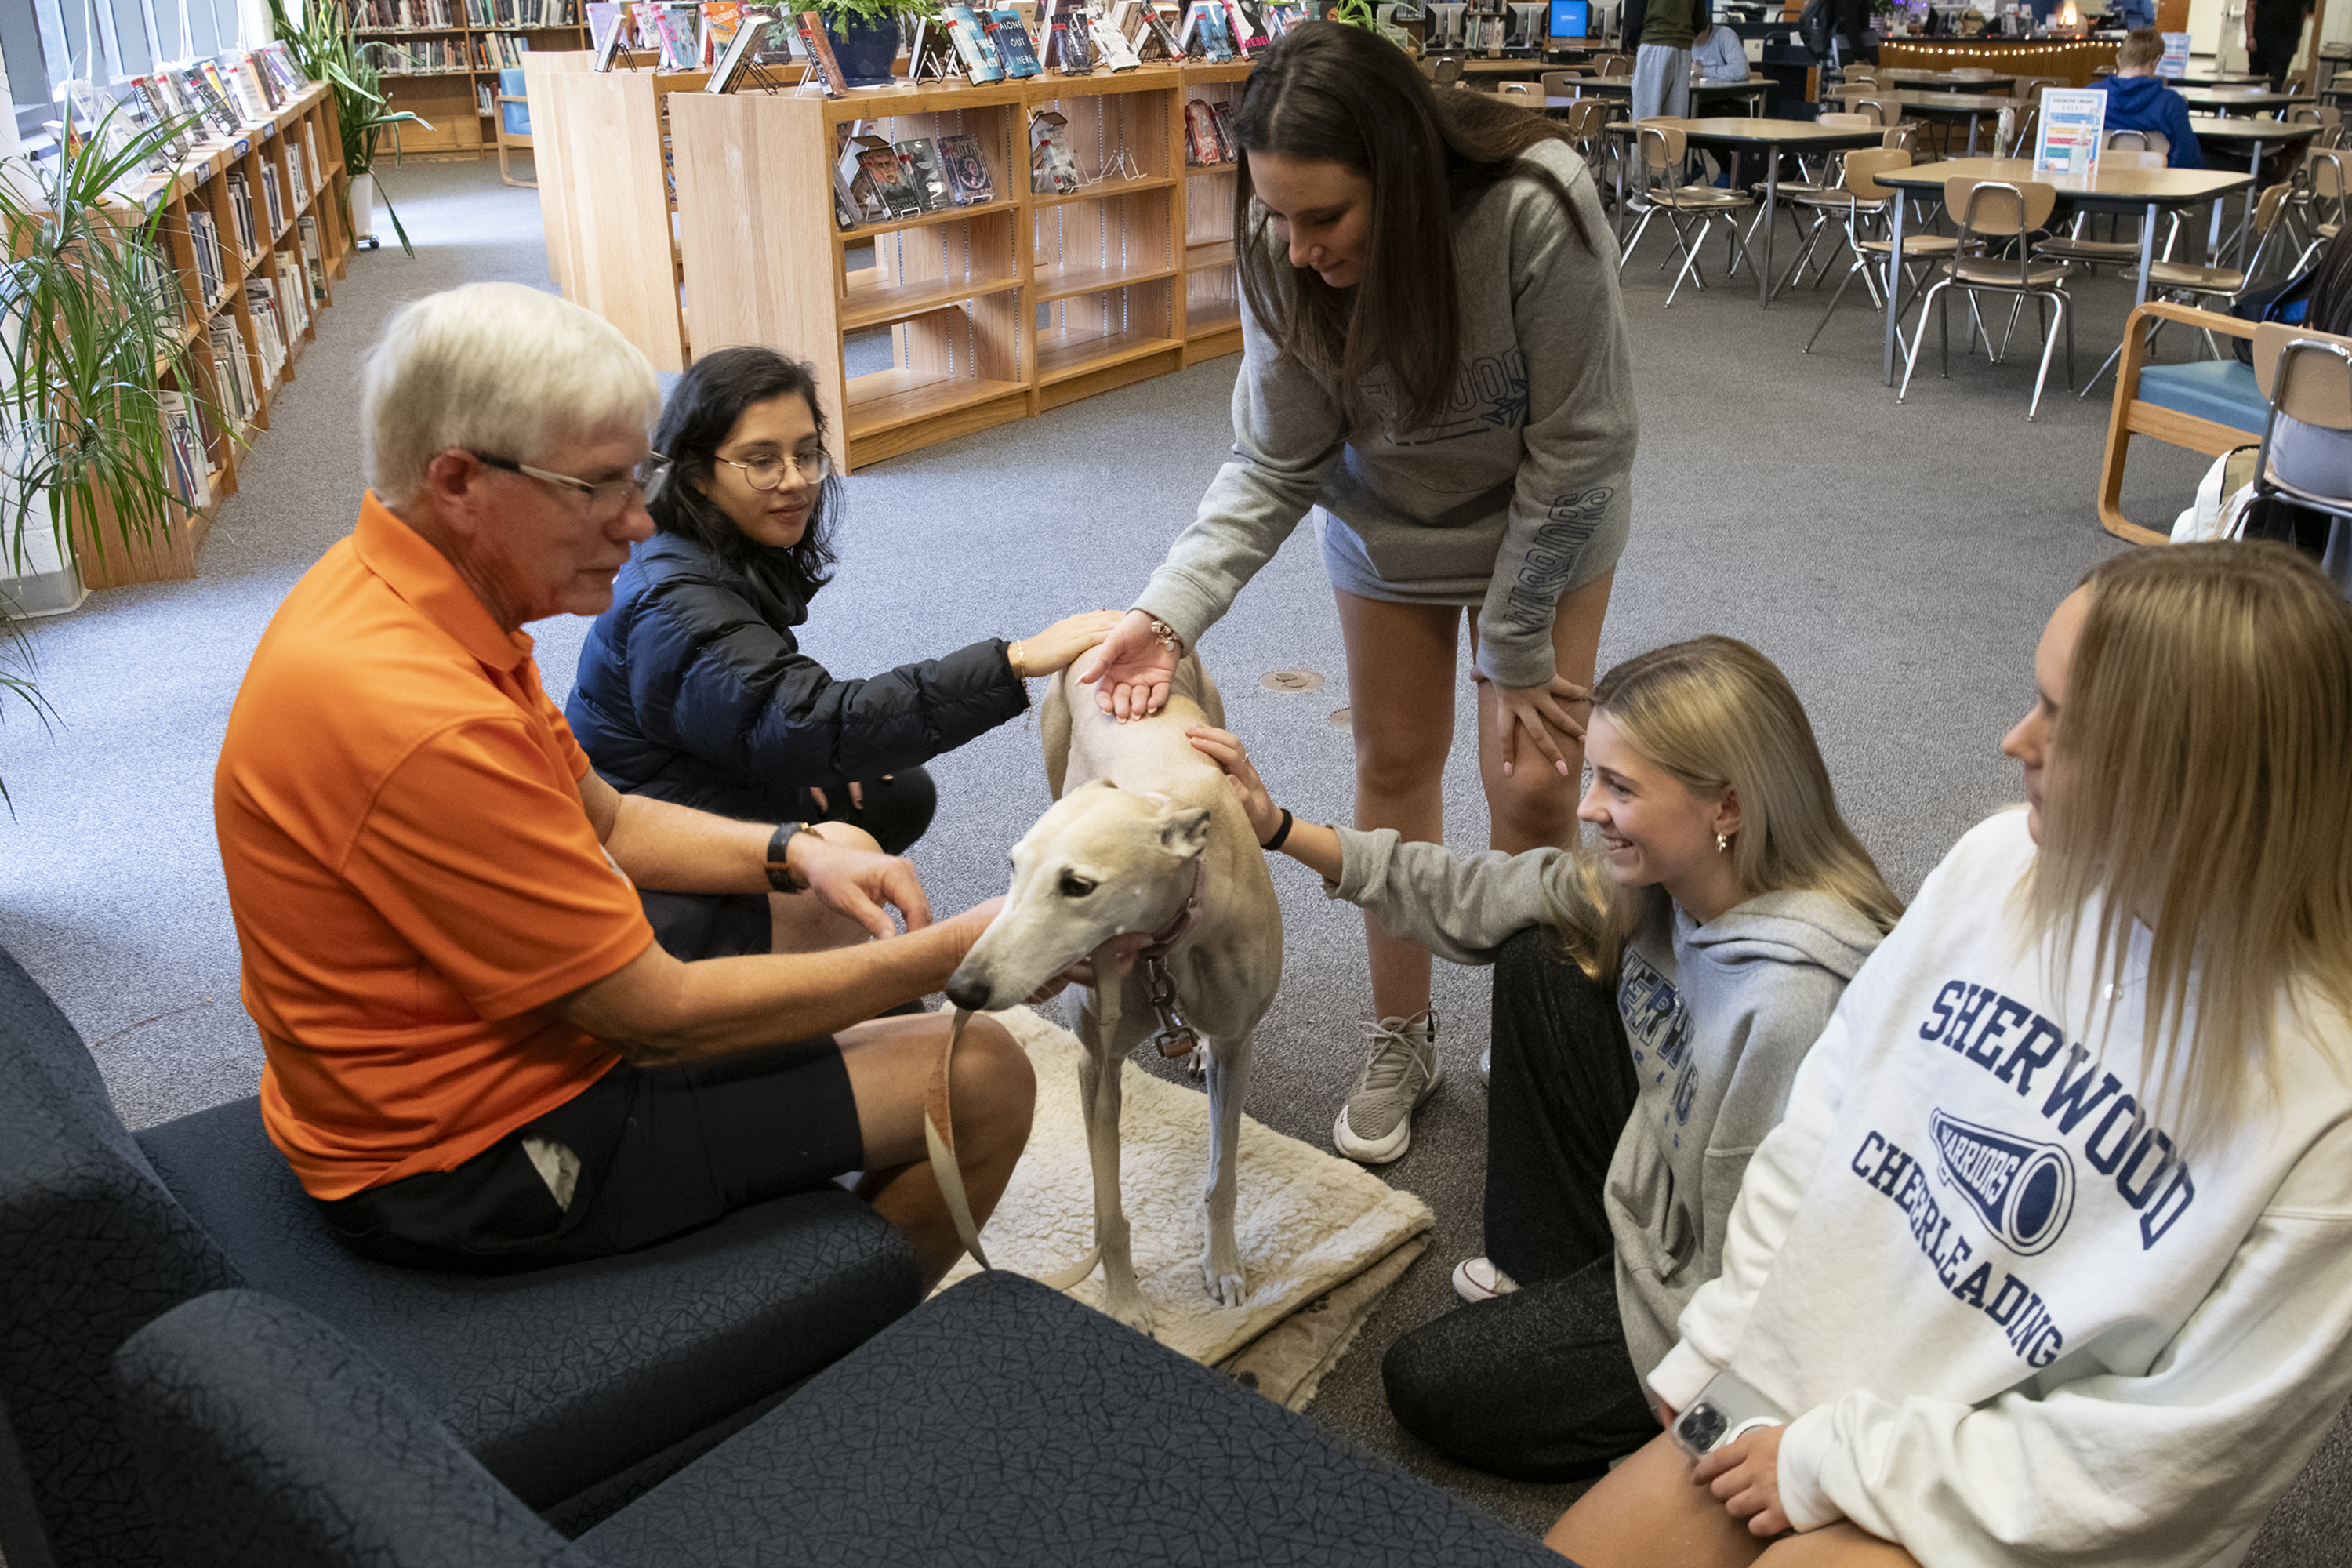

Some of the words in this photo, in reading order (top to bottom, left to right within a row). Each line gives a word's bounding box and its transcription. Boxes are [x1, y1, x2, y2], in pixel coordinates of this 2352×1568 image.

[712, 9, 739, 24] CELEBRANTS
[999, 20, 1024, 31] ALONE
[1010, 38, 1025, 47] OUT
[1245, 35, 1271, 49] REBEL
[1015, 55, 1034, 64] HERE
[891, 201, 920, 215] BEING
[1503, 486, 1614, 629] WARRIORS
[1918, 979, 2196, 1251] SHERWOOD
[1940, 1124, 2021, 1207] WARRIORS
[1851, 1130, 2064, 1369] CHEERLEADING
